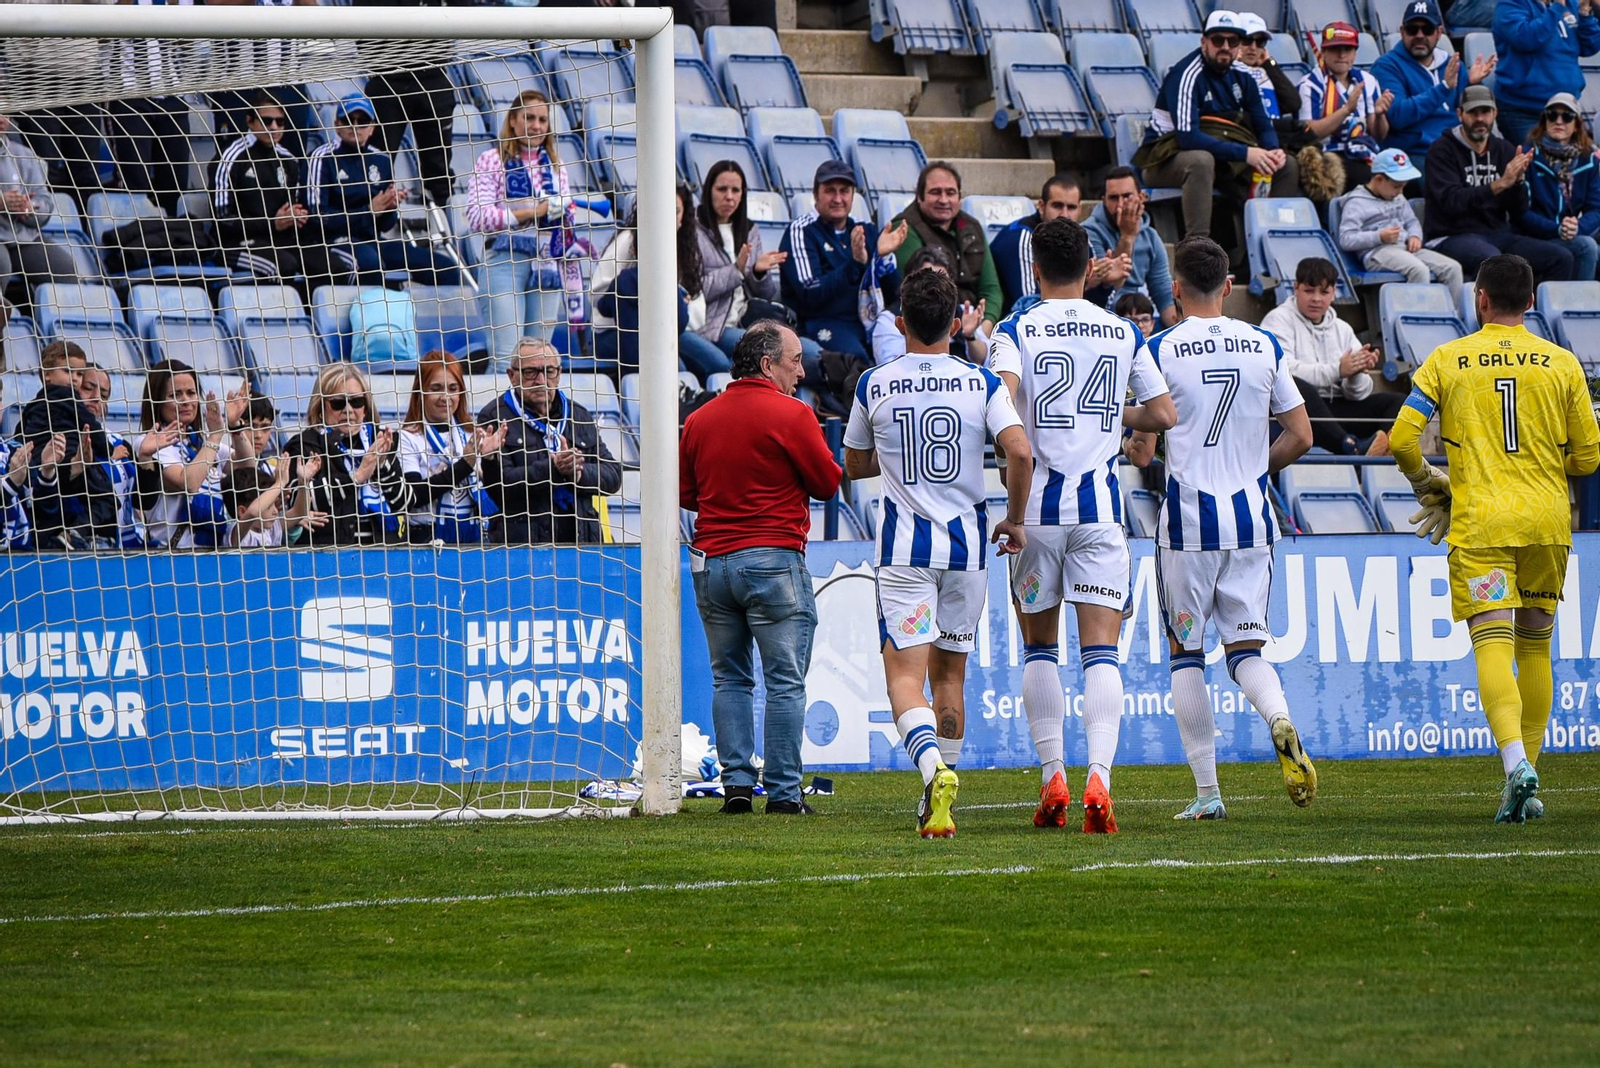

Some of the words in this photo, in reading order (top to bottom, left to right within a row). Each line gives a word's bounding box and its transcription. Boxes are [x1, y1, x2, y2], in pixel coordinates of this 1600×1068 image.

[1025, 324, 1041, 338] R.
[1044, 321, 1125, 340] SERRANO
[1173, 339, 1216, 358] IAGO
[1458, 355, 1471, 369] R.
[1478, 352, 1550, 367] GALVEZ
[870, 383, 887, 400] A.
[889, 377, 962, 395] ARJONA
[1033, 350, 1120, 433] 24
[1201, 368, 1240, 447] 7
[1494, 377, 1519, 453] 1
[892, 406, 962, 486] 18
[1073, 583, 1122, 600] ROMERO
[0, 631, 149, 679] UELVA
[466, 618, 634, 667] HUELVA
[939, 630, 973, 642] OMERO
[466, 678, 630, 726] MOTOR
[270, 726, 426, 759] SEAT
